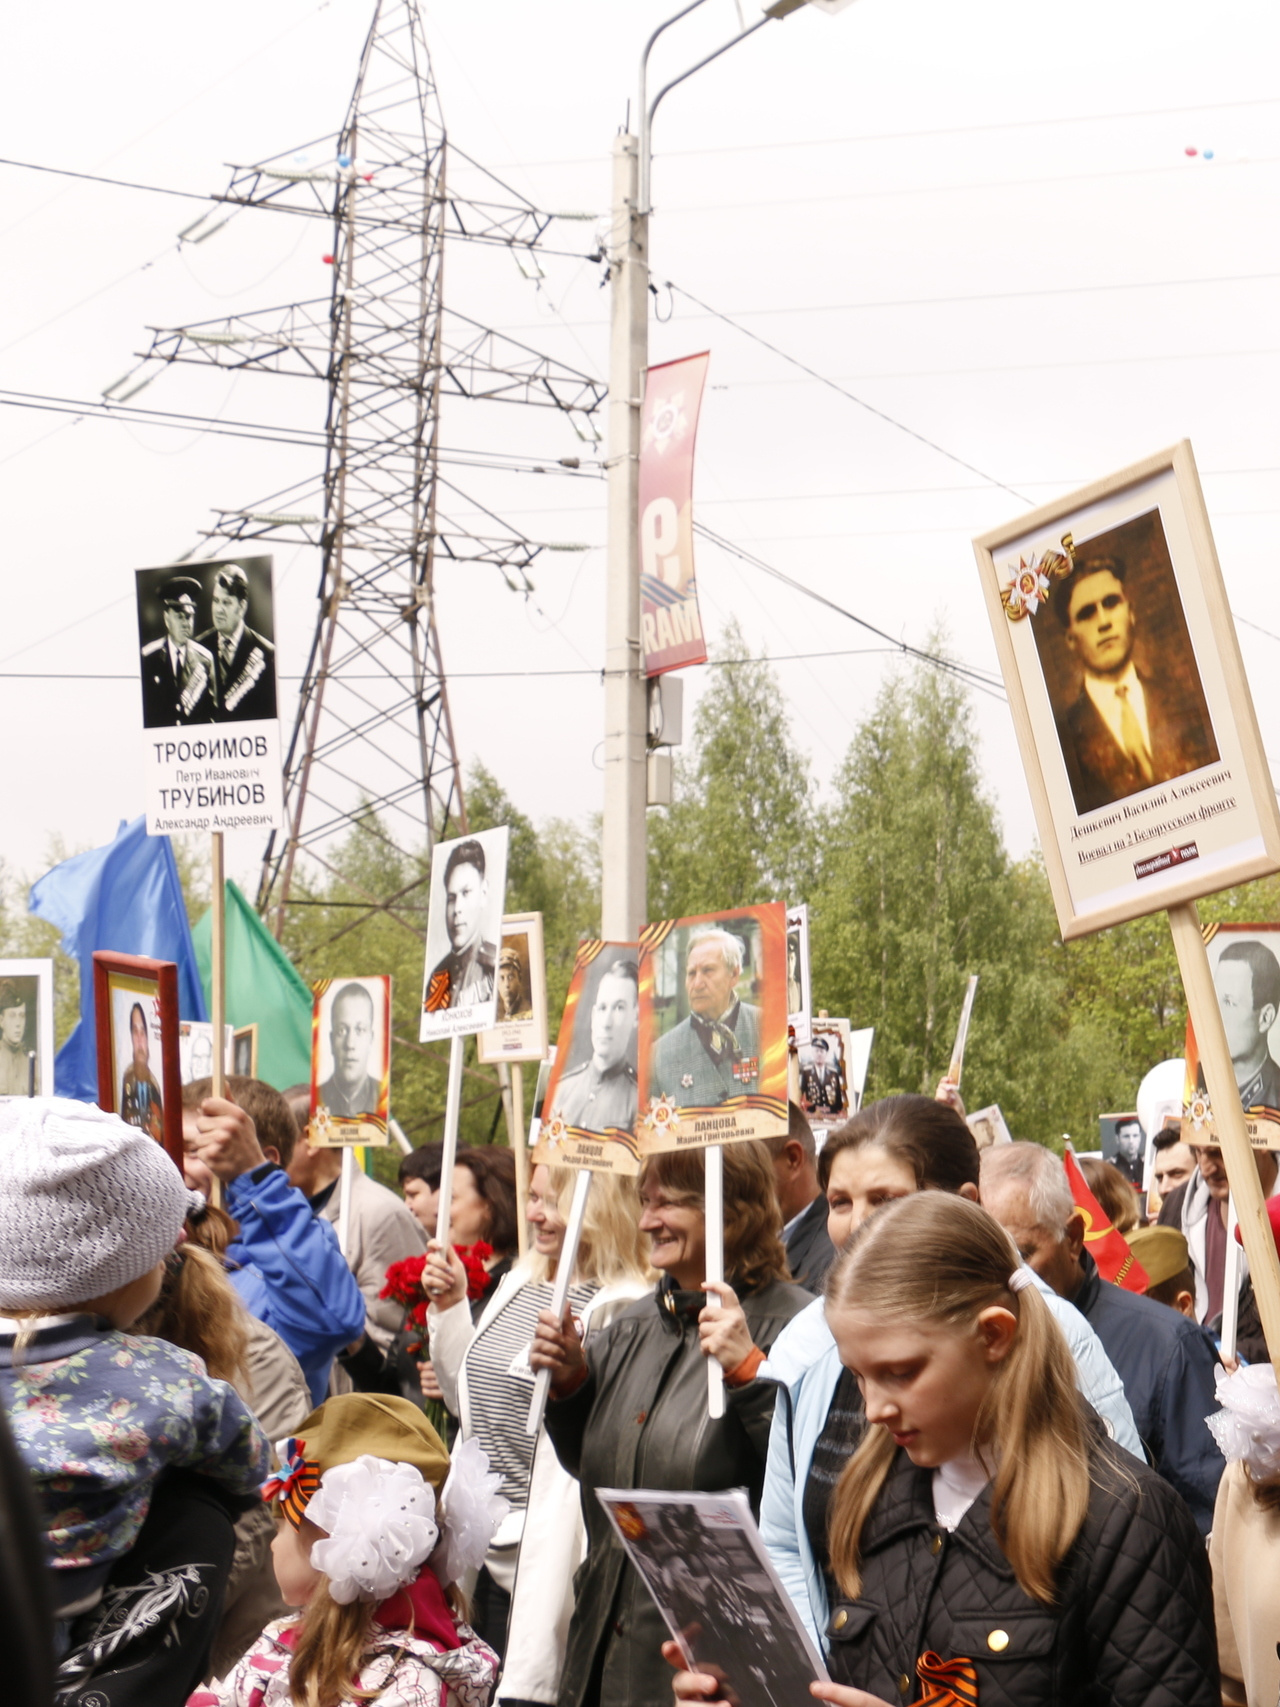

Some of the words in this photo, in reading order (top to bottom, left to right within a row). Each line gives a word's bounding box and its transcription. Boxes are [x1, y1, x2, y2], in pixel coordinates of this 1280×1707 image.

[153, 736, 268, 763] ТРОФИМОВ
[176, 769, 202, 784] Петр
[205, 768, 260, 781] Иванович
[159, 783, 265, 809] ТРУБИНОВ
[1123, 792, 1168, 819] Василий
[1170, 769, 1232, 800] Алексеевич
[155, 817, 210, 831] Александр
[213, 814, 273, 830] Андреевич
[1078, 844, 1113, 865] Воевал
[1113, 840, 1126, 852] на
[1134, 812, 1197, 843] Белорусском
[1199, 795, 1238, 822] фронте
[676, 1133, 703, 1145] Мария
[703, 1127, 755, 1143] Григорьевна
